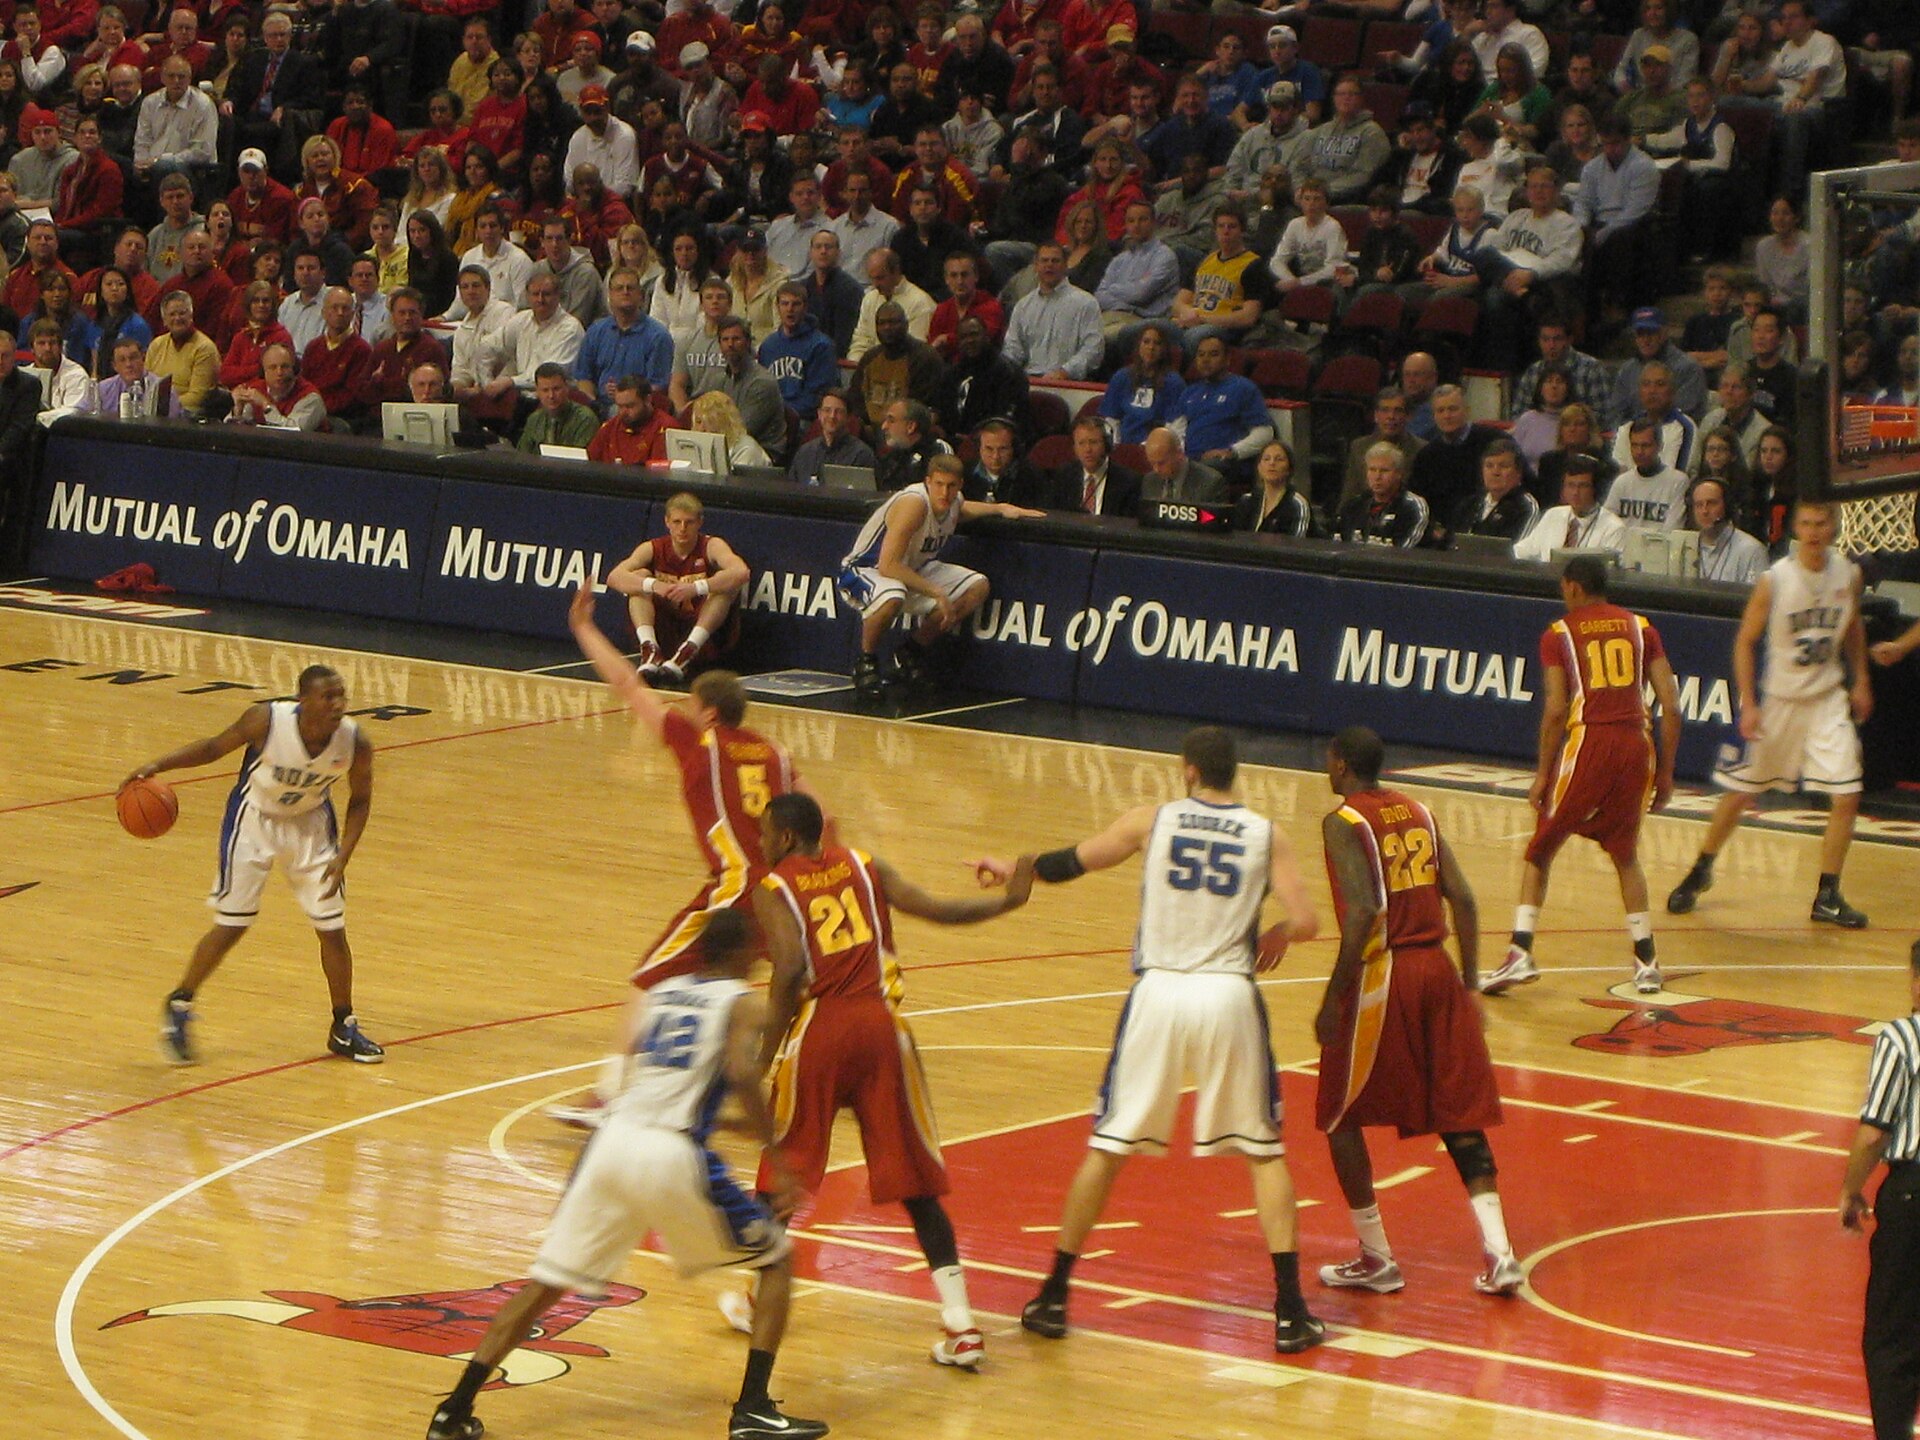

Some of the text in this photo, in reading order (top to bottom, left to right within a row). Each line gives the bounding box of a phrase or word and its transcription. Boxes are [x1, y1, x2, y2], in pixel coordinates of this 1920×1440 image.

[47, 481, 410, 570] MUTUAL of OMAHA
[1158, 503, 1199, 522] POSS
[1618, 498, 1670, 523] DUKE
[441, 525, 837, 620] MUTUAL AHA
[1065, 595, 1133, 666] of
[1131, 600, 1300, 672] OMAHA
[1580, 619, 1629, 635] GARRETT
[0, 658, 433, 721] ENTR
[1335, 626, 1534, 702] MUTUAL
[1586, 637, 1635, 689] 10
[737, 763, 772, 817] 5
[1168, 835, 1246, 897] 55
[1383, 827, 1436, 892] 22
[808, 886, 874, 957] 21
